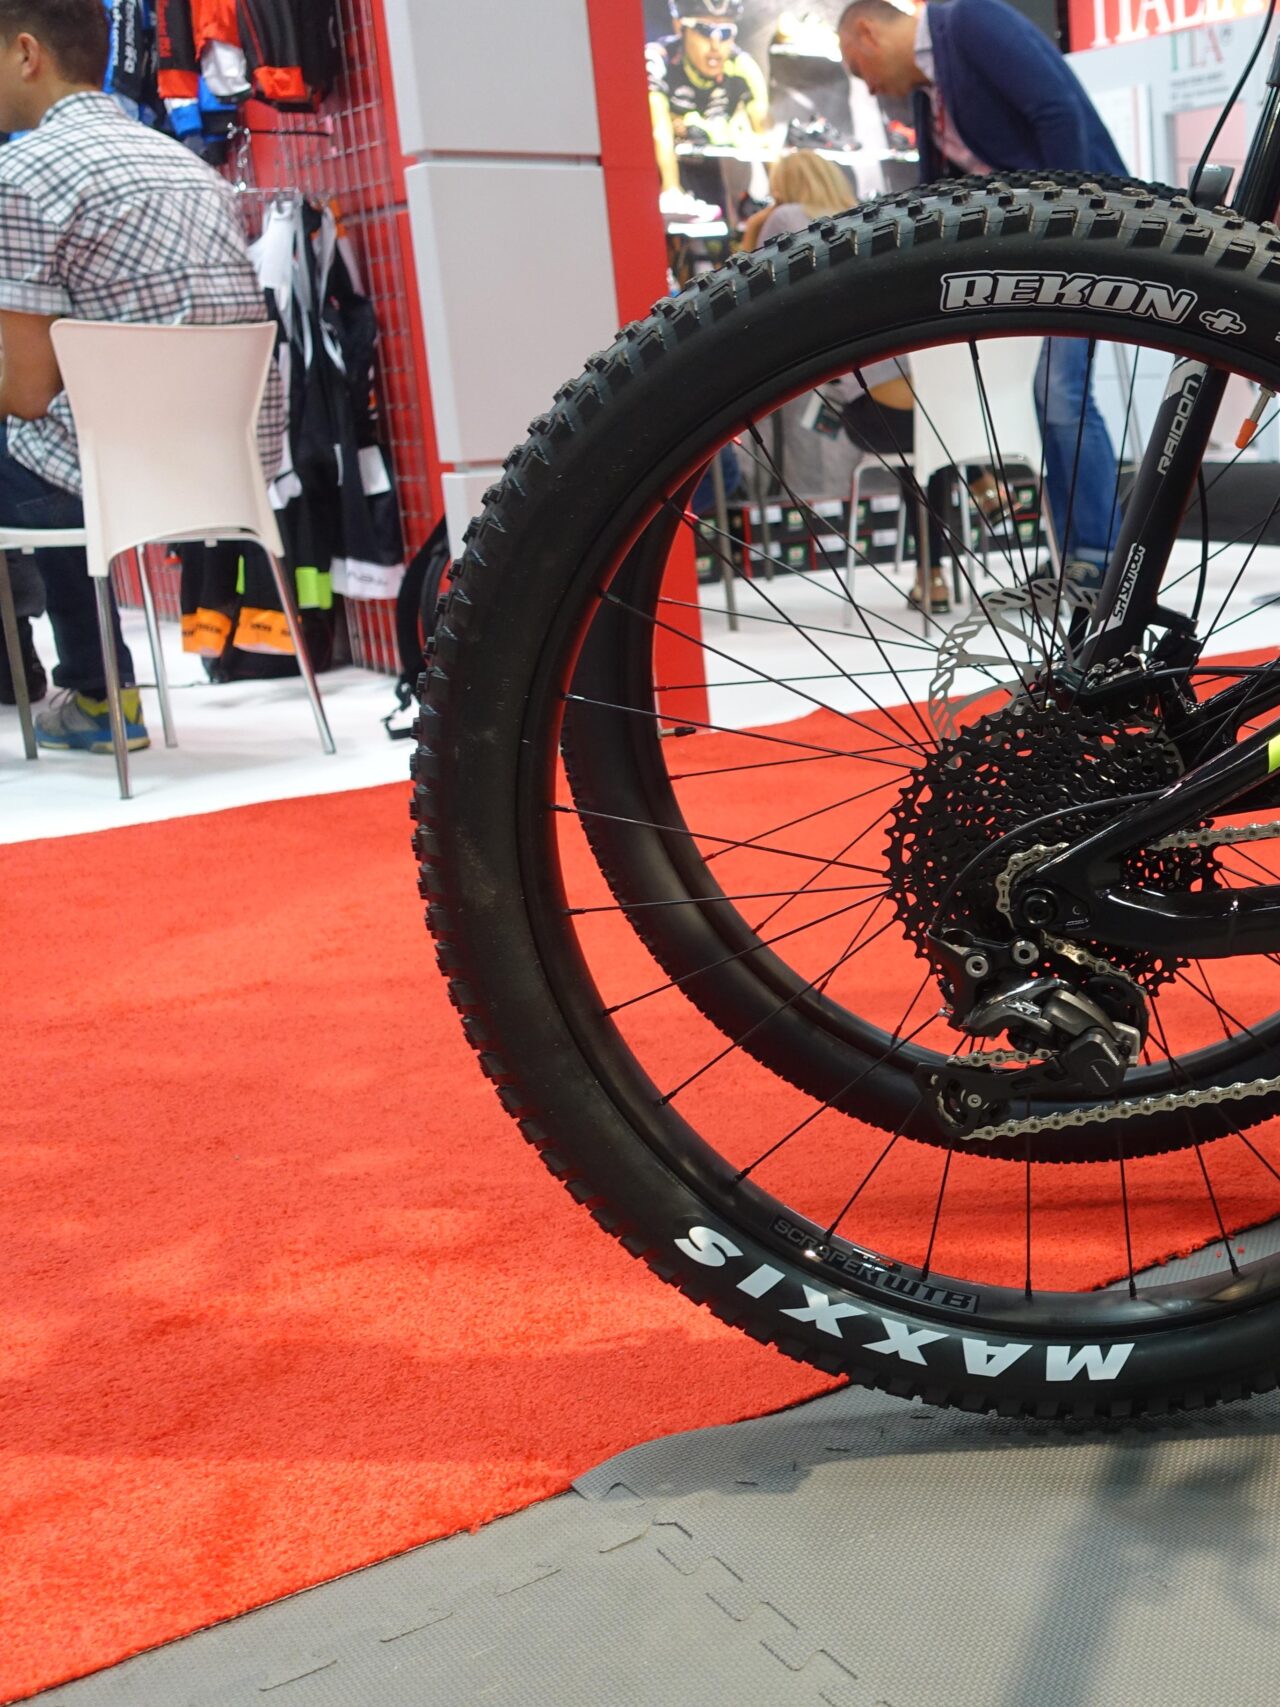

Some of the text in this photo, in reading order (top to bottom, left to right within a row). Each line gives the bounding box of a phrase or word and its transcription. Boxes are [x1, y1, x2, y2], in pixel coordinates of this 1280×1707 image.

[940, 270, 1197, 324] REKON
[1157, 379, 1199, 475] RAIDON
[1006, 1001, 1042, 1016] XT
[673, 1225, 1136, 1382] MAXXIS
[773, 1219, 876, 1281] SCRAPER
[883, 1273, 973, 1311] WTB
